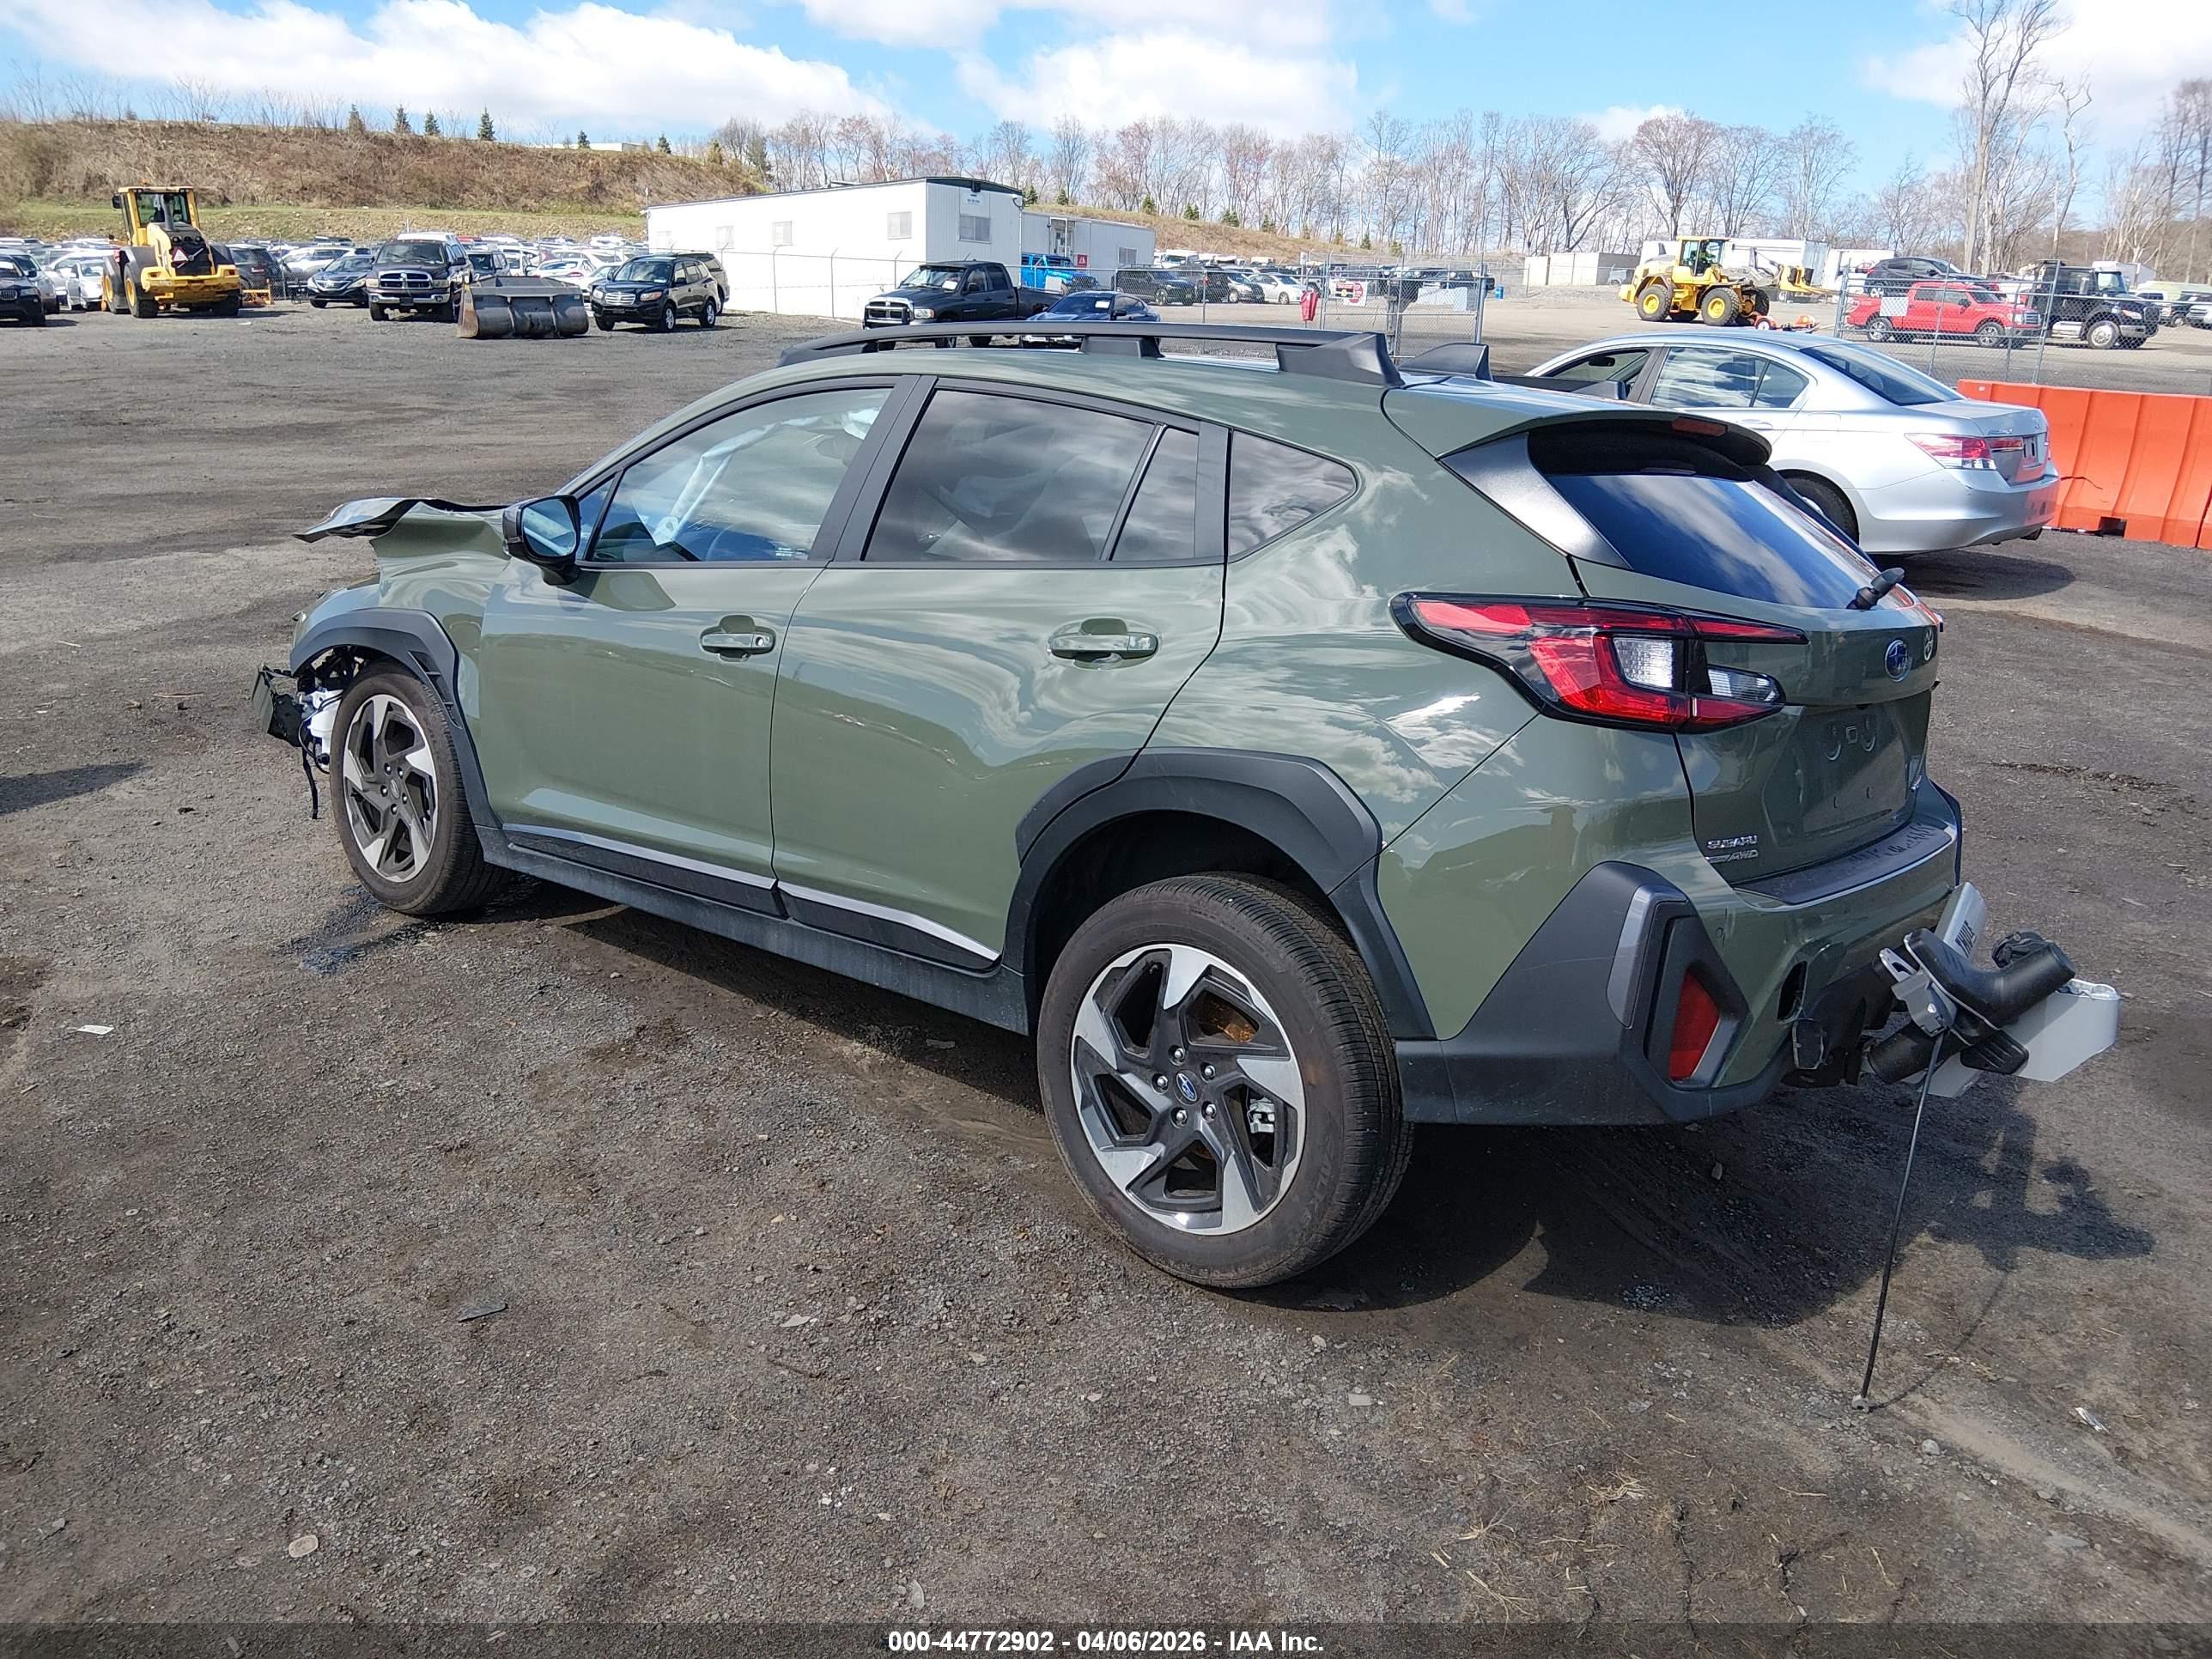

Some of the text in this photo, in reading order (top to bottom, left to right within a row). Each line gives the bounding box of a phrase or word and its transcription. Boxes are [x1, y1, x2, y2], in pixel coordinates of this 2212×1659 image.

[1706, 835, 1758, 850] SUBARU
[1727, 849, 1759, 862] AWD
[1954, 920, 1976, 958] THULE
